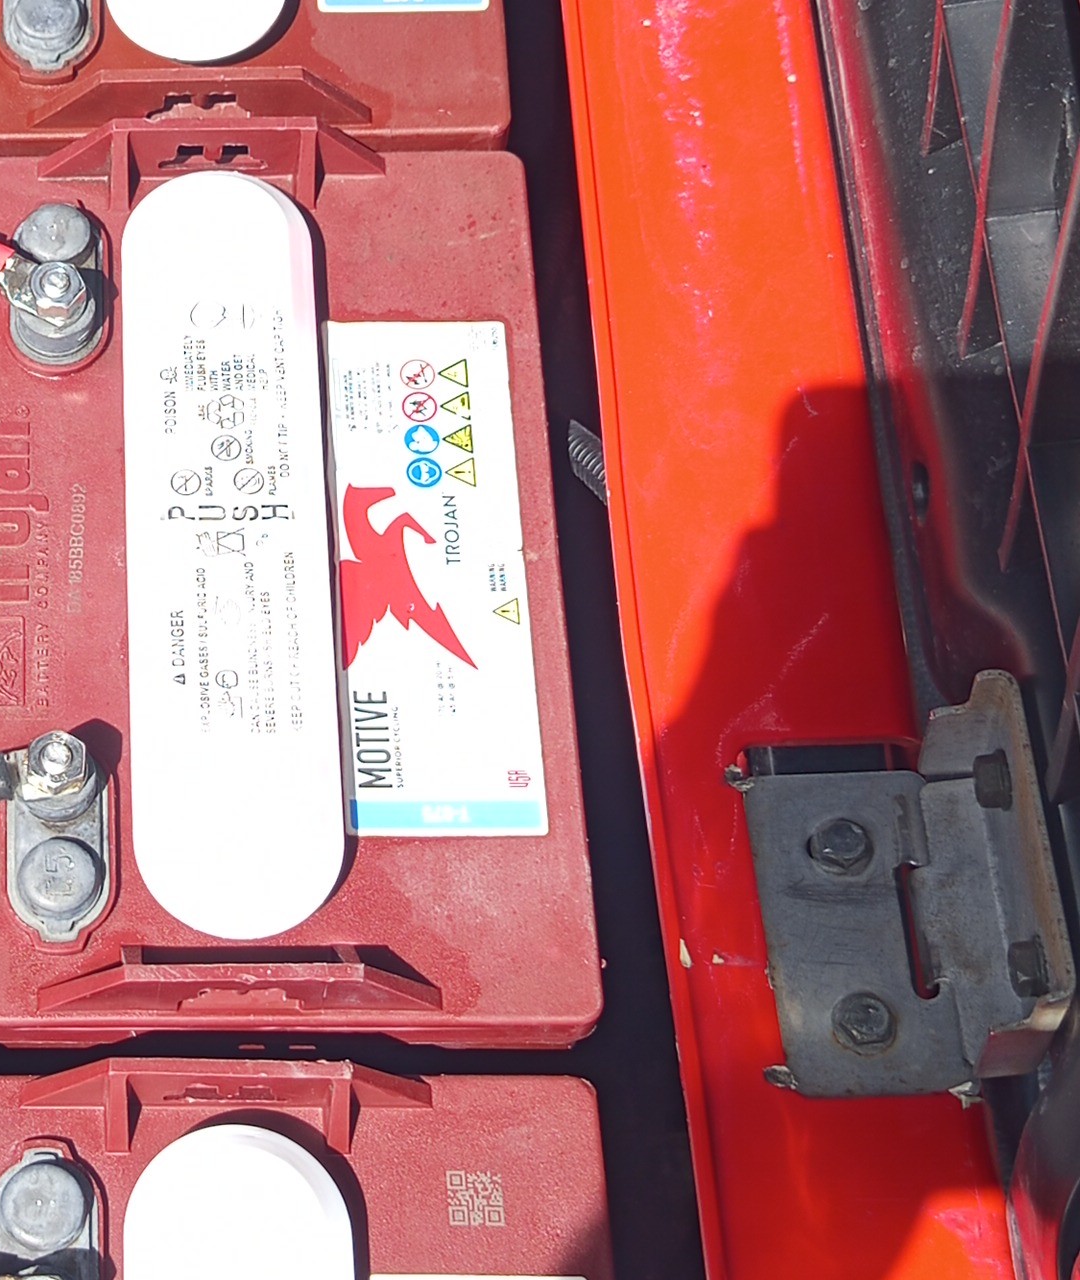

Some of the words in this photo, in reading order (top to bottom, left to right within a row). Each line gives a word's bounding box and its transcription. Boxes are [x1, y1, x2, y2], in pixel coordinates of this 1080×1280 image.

[164, 391, 177, 434] POISON
[167, 505, 289, 520] PUSH
[442, 494, 461, 565] TROJAN
[38, 521, 48, 610] COMPANY
[38, 622, 50, 708] BATTERY
[170, 610, 185, 667] DANGER
[353, 690, 393, 788] MOTIVE
